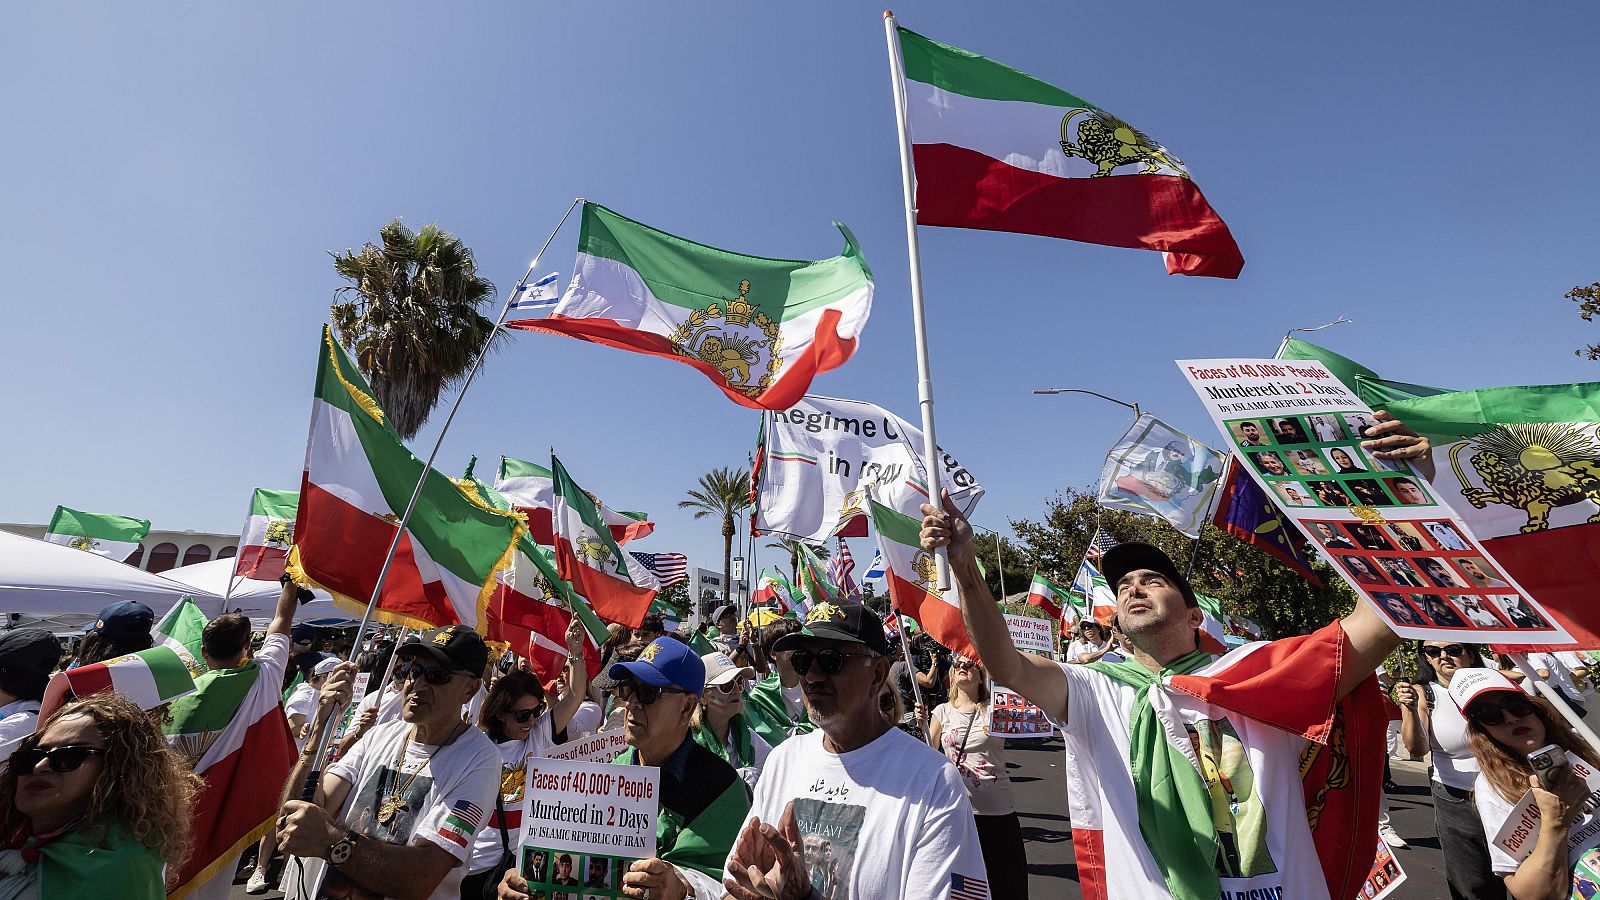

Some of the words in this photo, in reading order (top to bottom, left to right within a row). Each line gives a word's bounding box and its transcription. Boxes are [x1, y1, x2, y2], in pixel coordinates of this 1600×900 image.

[1188, 366, 1228, 380] Faces
[1225, 364, 1241, 378] of
[1239, 364, 1286, 379] 40,000+
[1286, 365, 1330, 380] People
[1204, 382, 1280, 400] Murdered
[1276, 381, 1300, 395] in
[1295, 381, 1312, 394] 2
[1308, 383, 1347, 399] Days
[1217, 403, 1232, 414] by
[1231, 400, 1273, 412] ISLAMIC
[1274, 398, 1321, 409] REPUBLIC
[1319, 398, 1336, 406] OF
[1333, 398, 1359, 407] IRAN
[829, 451, 850, 477] in
[571, 746, 577, 759] of
[579, 738, 609, 757] 40,000+
[610, 735, 627, 747] Peop
[531, 768, 559, 791] Faces
[560, 771, 572, 792] of
[572, 771, 616, 797] 40,000+
[617, 775, 653, 802] People
[809, 778, 825, 793] شاه
[529, 799, 588, 824] Murdered
[590, 804, 603, 826] in
[606, 806, 615, 826] 2
[618, 808, 649, 834] Days
[528, 825, 538, 839] by
[538, 826, 570, 841] ISLAMIC
[571, 830, 610, 845] REPUBLIC
[612, 834, 623, 847] OF
[624, 836, 647, 848] IRAN
[798, 820, 842, 838] PAHLAVI
[1502, 825, 1530, 853] Faces
[1521, 813, 1536, 830] of
